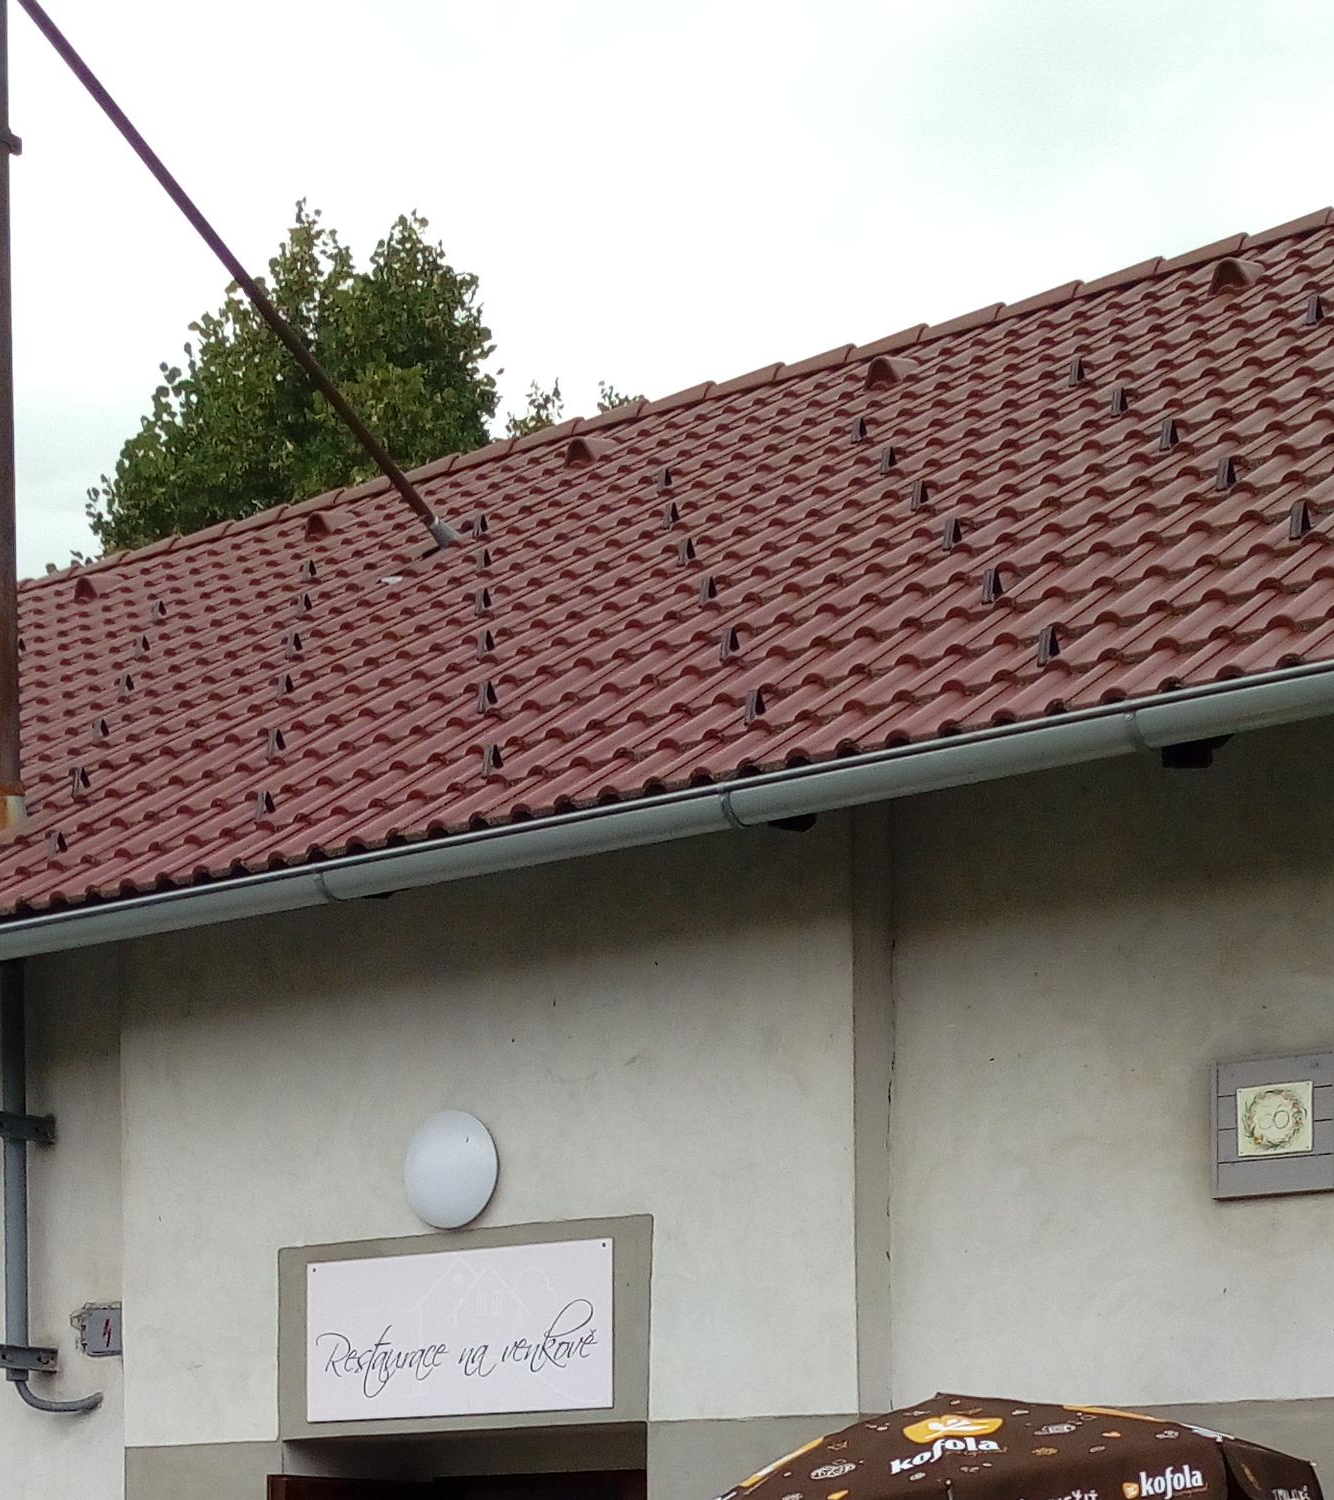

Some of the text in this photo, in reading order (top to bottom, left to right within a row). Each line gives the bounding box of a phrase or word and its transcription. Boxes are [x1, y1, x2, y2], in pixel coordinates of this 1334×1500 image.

[316, 1298, 598, 1398] Restaurace na venkově
[890, 1437, 1000, 1475] kofola
[1139, 1464, 1204, 1500] kofola
